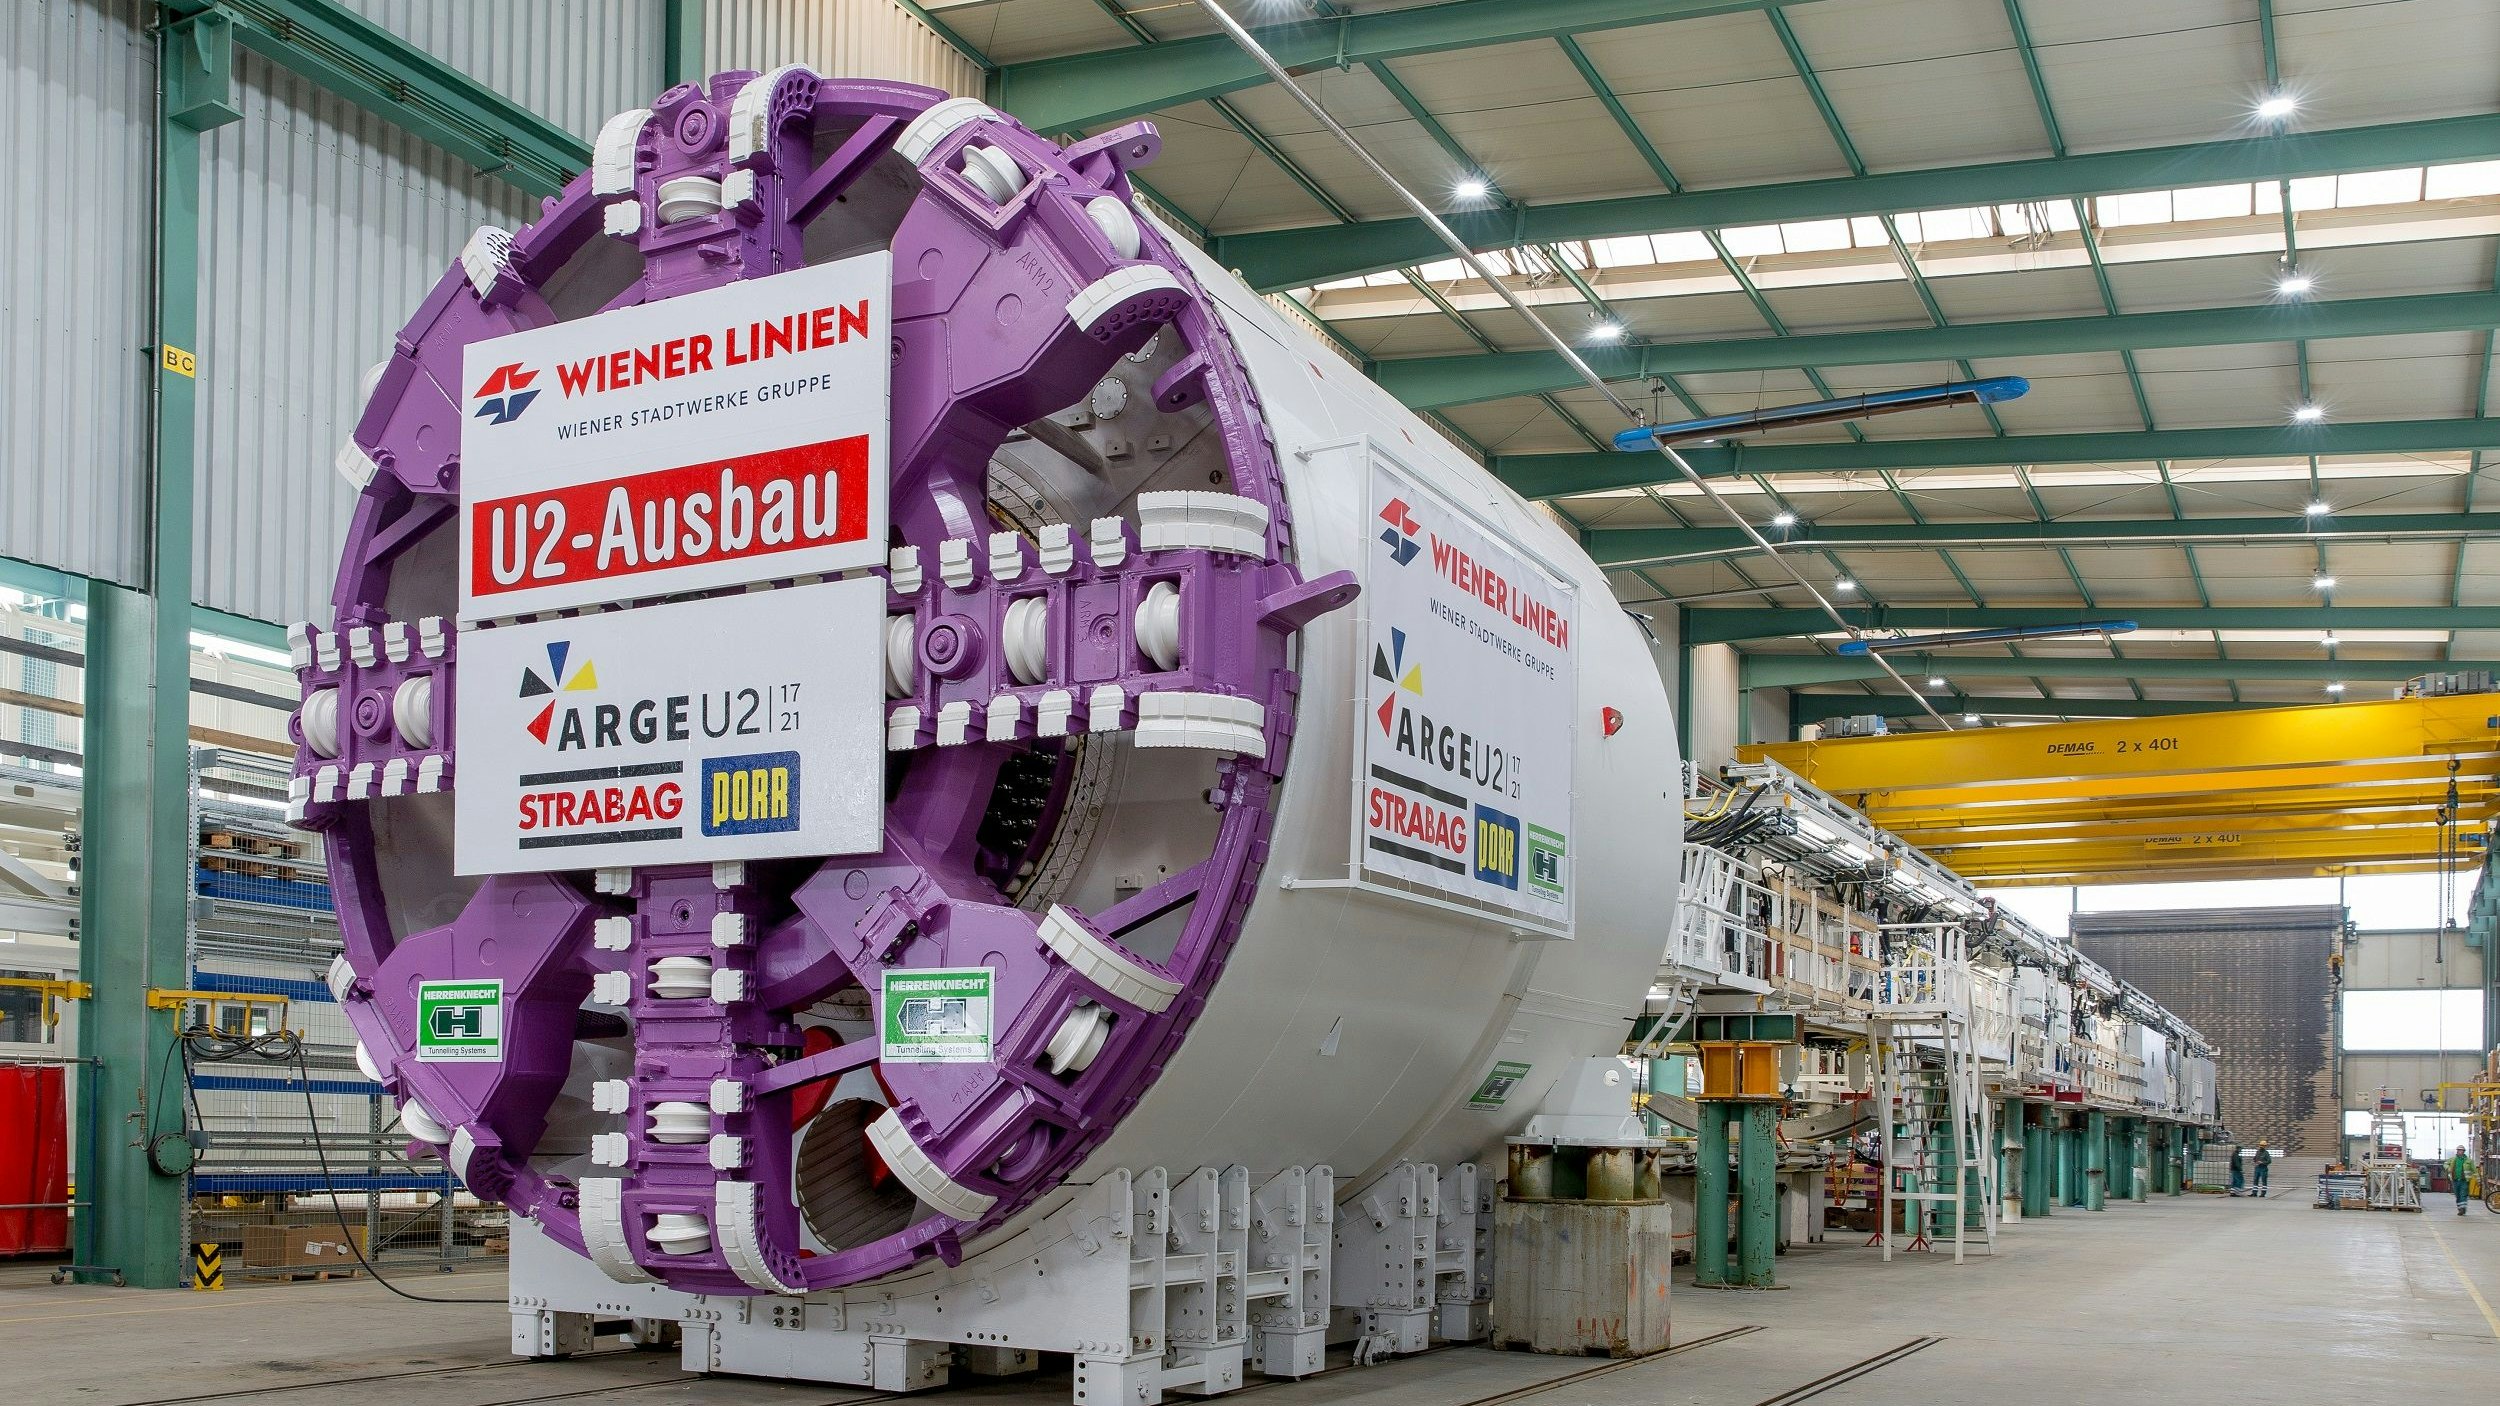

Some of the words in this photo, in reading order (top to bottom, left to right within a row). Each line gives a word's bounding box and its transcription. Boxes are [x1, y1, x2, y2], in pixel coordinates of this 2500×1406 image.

[556, 333, 714, 400] WIENER
[725, 299, 869, 367] LINIEN
[557, 414, 623, 441] WIENER
[631, 390, 749, 426] STADTWERKE
[757, 374, 832, 402] GRUPPE
[491, 467, 838, 586] U2-Ausbau
[1430, 532, 1508, 616] WIENER
[1512, 586, 1568, 653] LINIEN
[1430, 597, 1466, 631] WIENER
[1469, 619, 1521, 663] STADTWERKE
[1525, 653, 1554, 681] GRUPPE
[558, 695, 690, 752] ARGE
[702, 687, 760, 739] U2
[781, 683, 801, 703] 17
[780, 711, 800, 731] 21
[1396, 707, 1472, 780] ARGE
[1475, 740, 1503, 793] U2
[1512, 755, 1521, 775] 17
[2047, 742, 2095, 754] DEMAG
[2117, 741, 2127, 753] 2
[2133, 742, 2142, 752] x
[2149, 738, 2178, 751] 40t
[518, 781, 684, 830] STRABAG
[712, 767, 788, 828] PORR
[1511, 781, 1521, 800] 21
[1369, 787, 1467, 854] STRABAG
[1478, 818, 1515, 877] PORR
[424, 989, 497, 1001] HERRENKNECHT
[890, 978, 986, 991] HERRENKNECHT
[428, 1047, 459, 1055] Tunnelling
[460, 1046, 487, 1055] Systems
